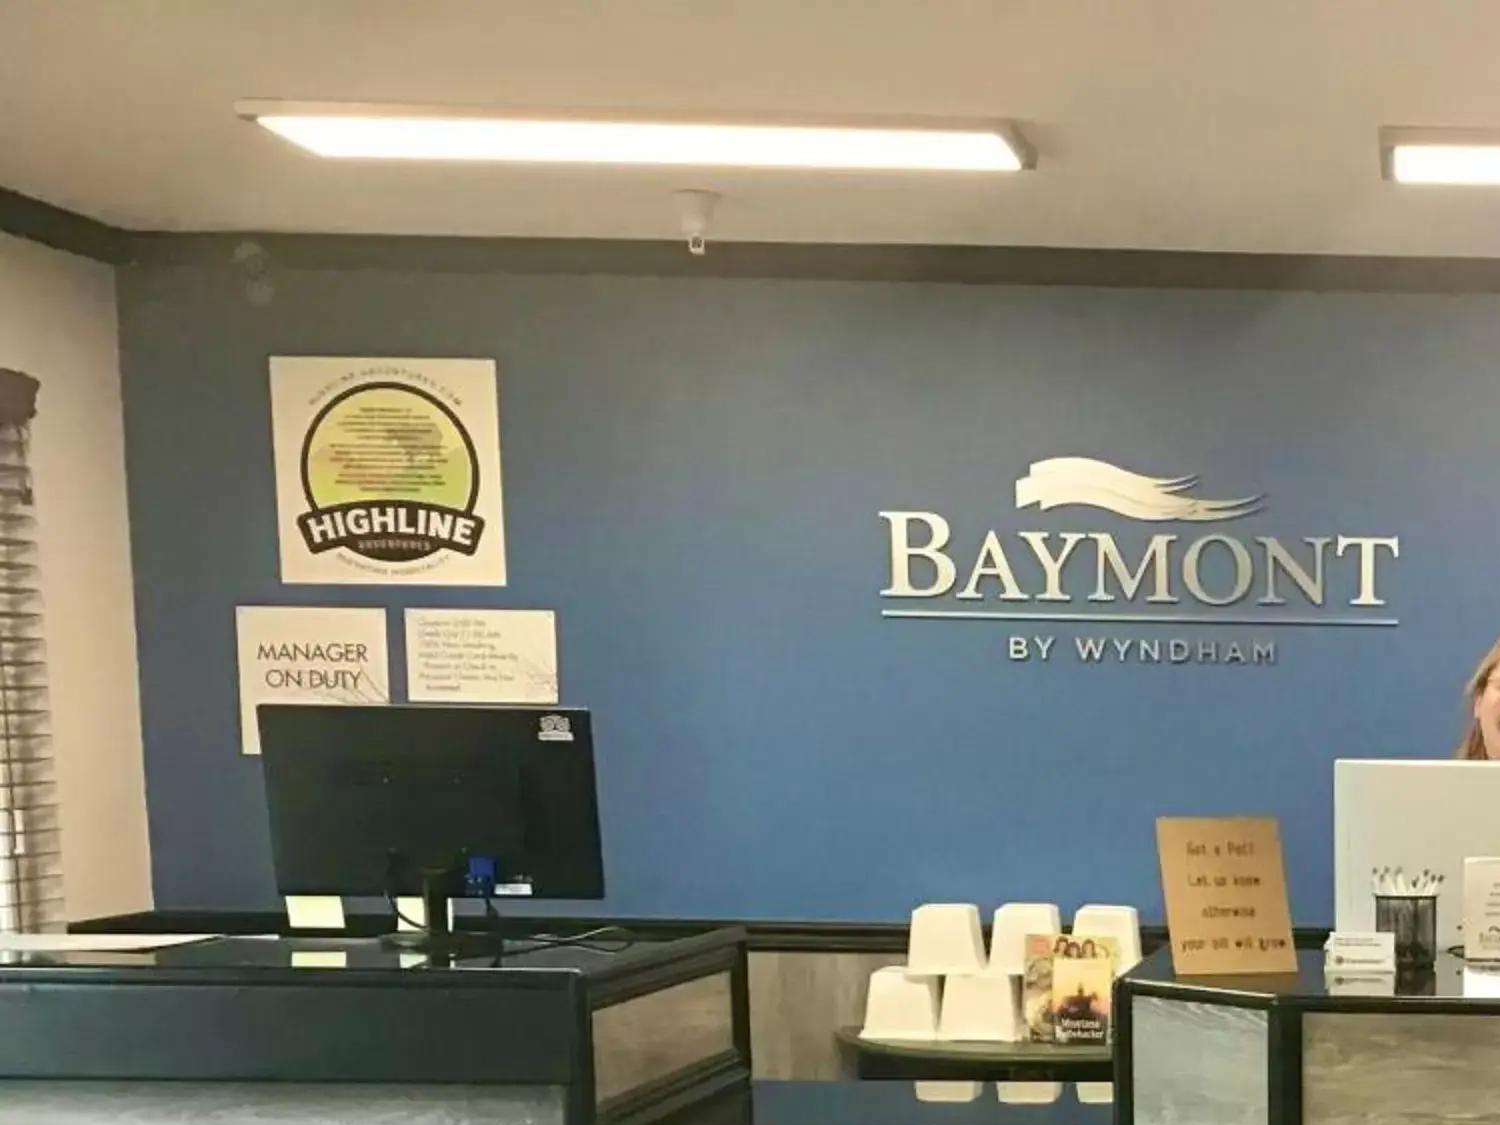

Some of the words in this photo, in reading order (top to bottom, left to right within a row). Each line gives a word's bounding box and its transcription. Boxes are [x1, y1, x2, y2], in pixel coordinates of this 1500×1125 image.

[307, 507, 475, 546] HIGHLINE
[879, 511, 1399, 608] BAYMONT
[257, 642, 369, 662] MANAGER
[1009, 636, 1056, 660] BY
[1075, 637, 1277, 664] WYNDHAM
[265, 669, 302, 688] ON
[310, 670, 361, 689] DUTY
